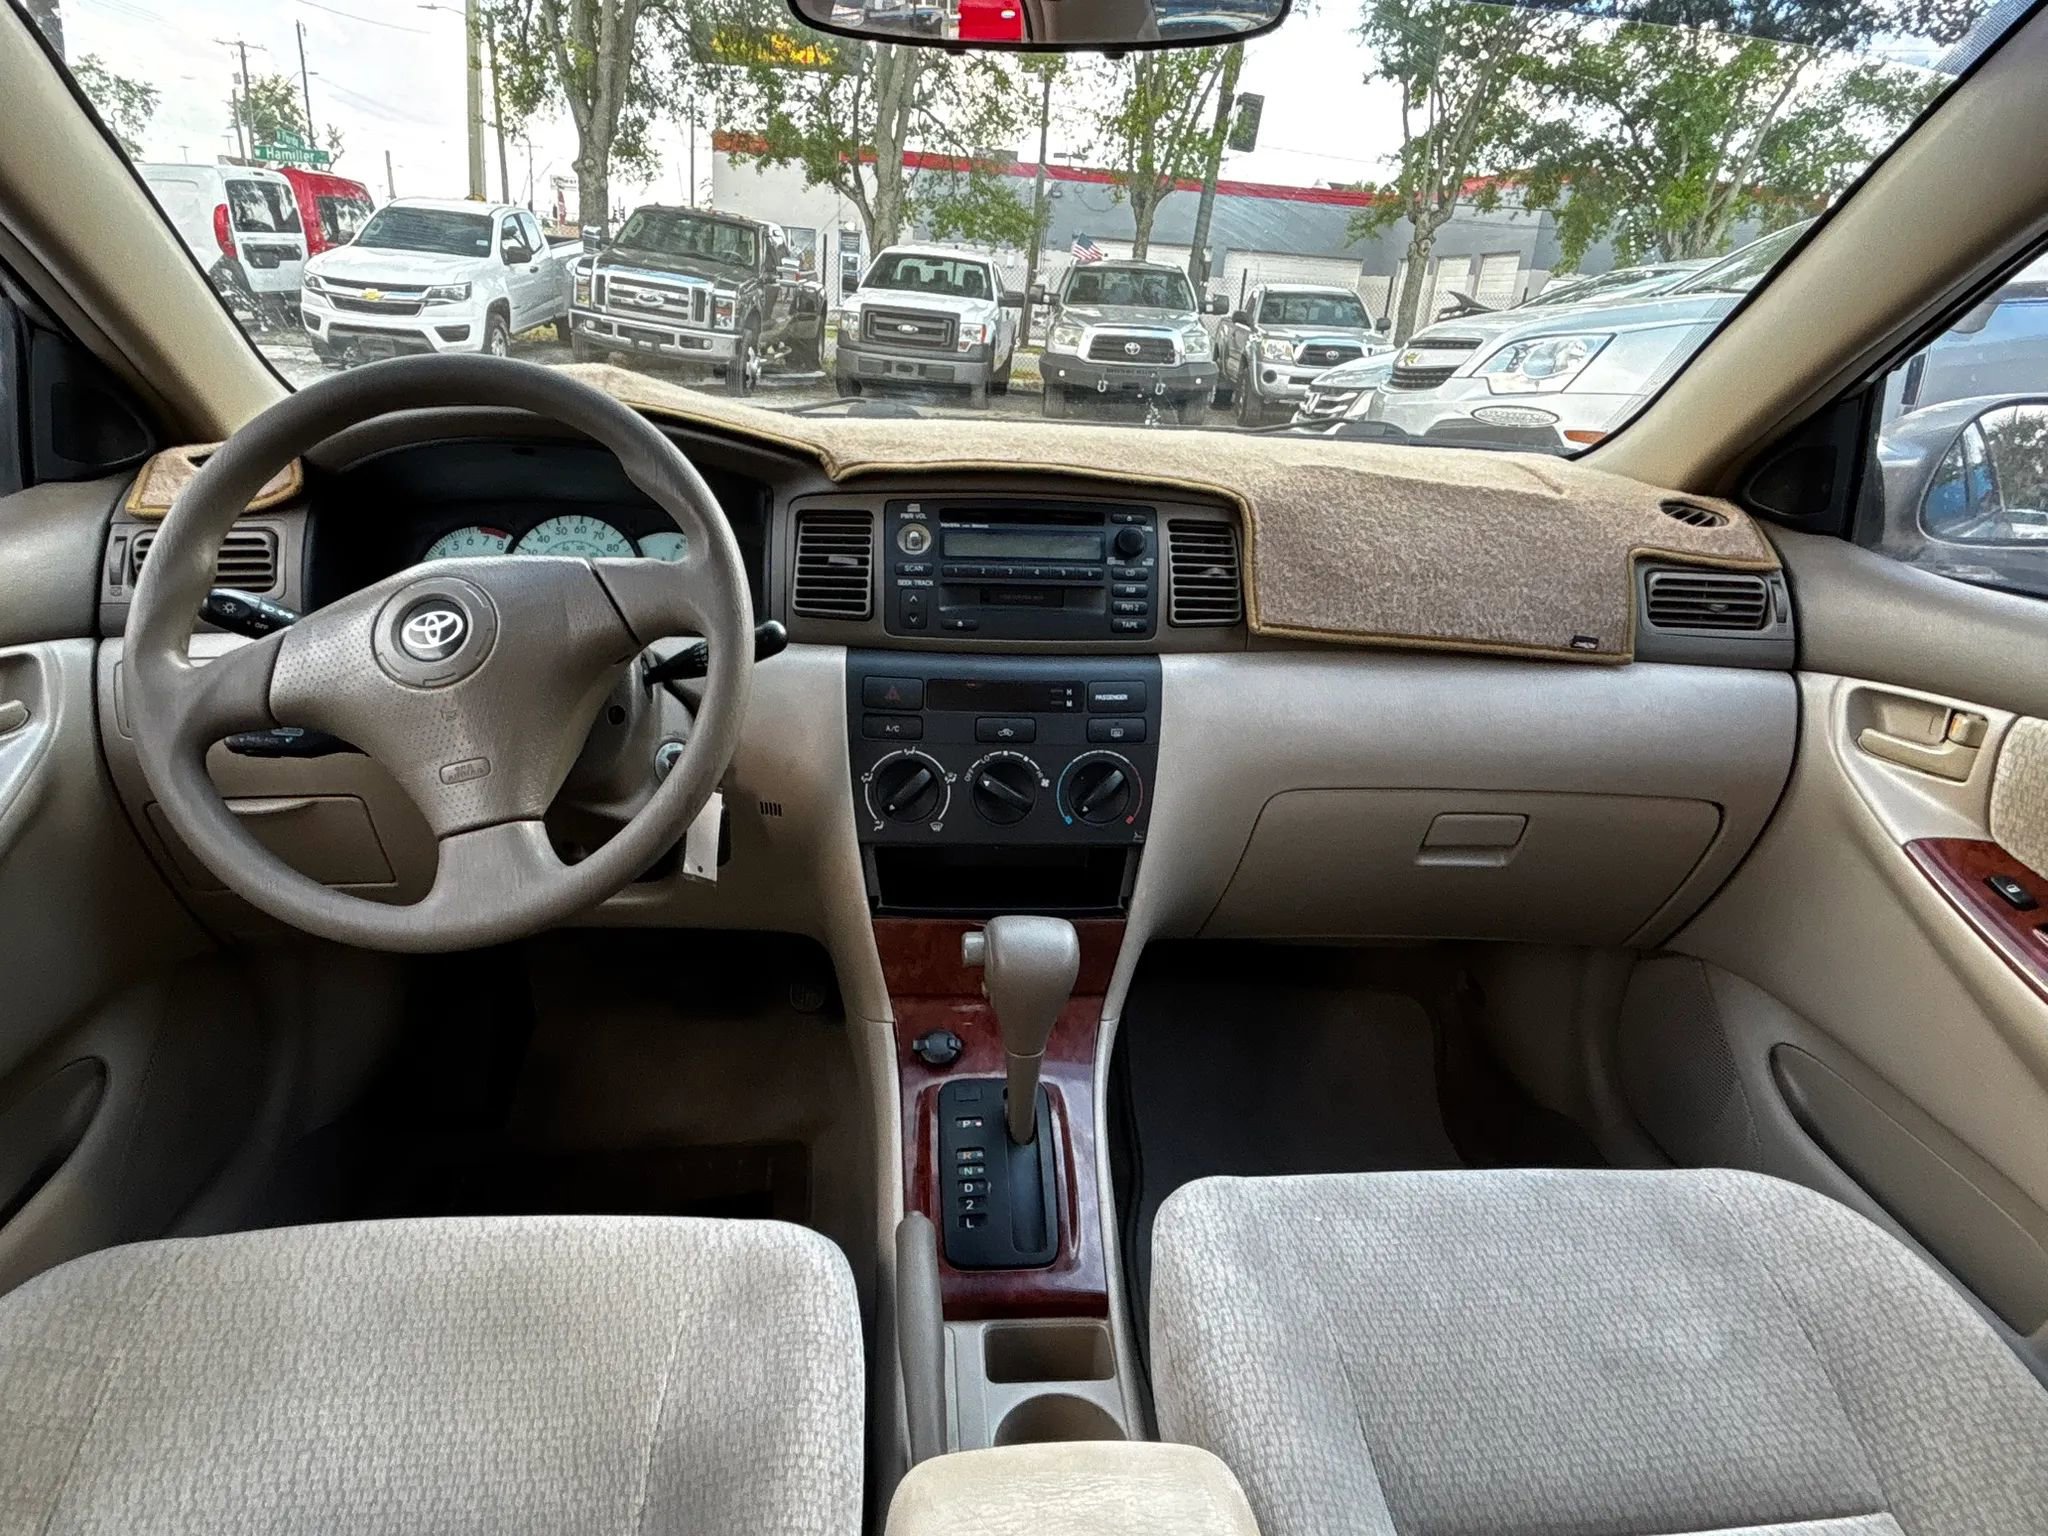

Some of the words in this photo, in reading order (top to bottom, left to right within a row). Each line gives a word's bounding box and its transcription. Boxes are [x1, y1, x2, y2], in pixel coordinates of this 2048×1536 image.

[266, 147, 315, 161] Hamiller
[555, 526, 568, 536] 50
[574, 525, 587, 534] 60
[466, 536, 474, 546] 6
[482, 535, 490, 545] 7
[537, 535, 550, 544] 40
[593, 531, 605, 541] 70
[452, 540, 460, 551] 5
[496, 541, 504, 550] 8
[606, 543, 620, 552] 80
[438, 547, 446, 557] 4
[1125, 569, 1136, 577] CD
[885, 725, 900, 733] A/C
[963, 1120, 971, 1128] P
[963, 1151, 972, 1159] R
[964, 1167, 972, 1175] N
[964, 1183, 973, 1193] D
[966, 1200, 974, 1210] 2
[966, 1218, 974, 1228] L
